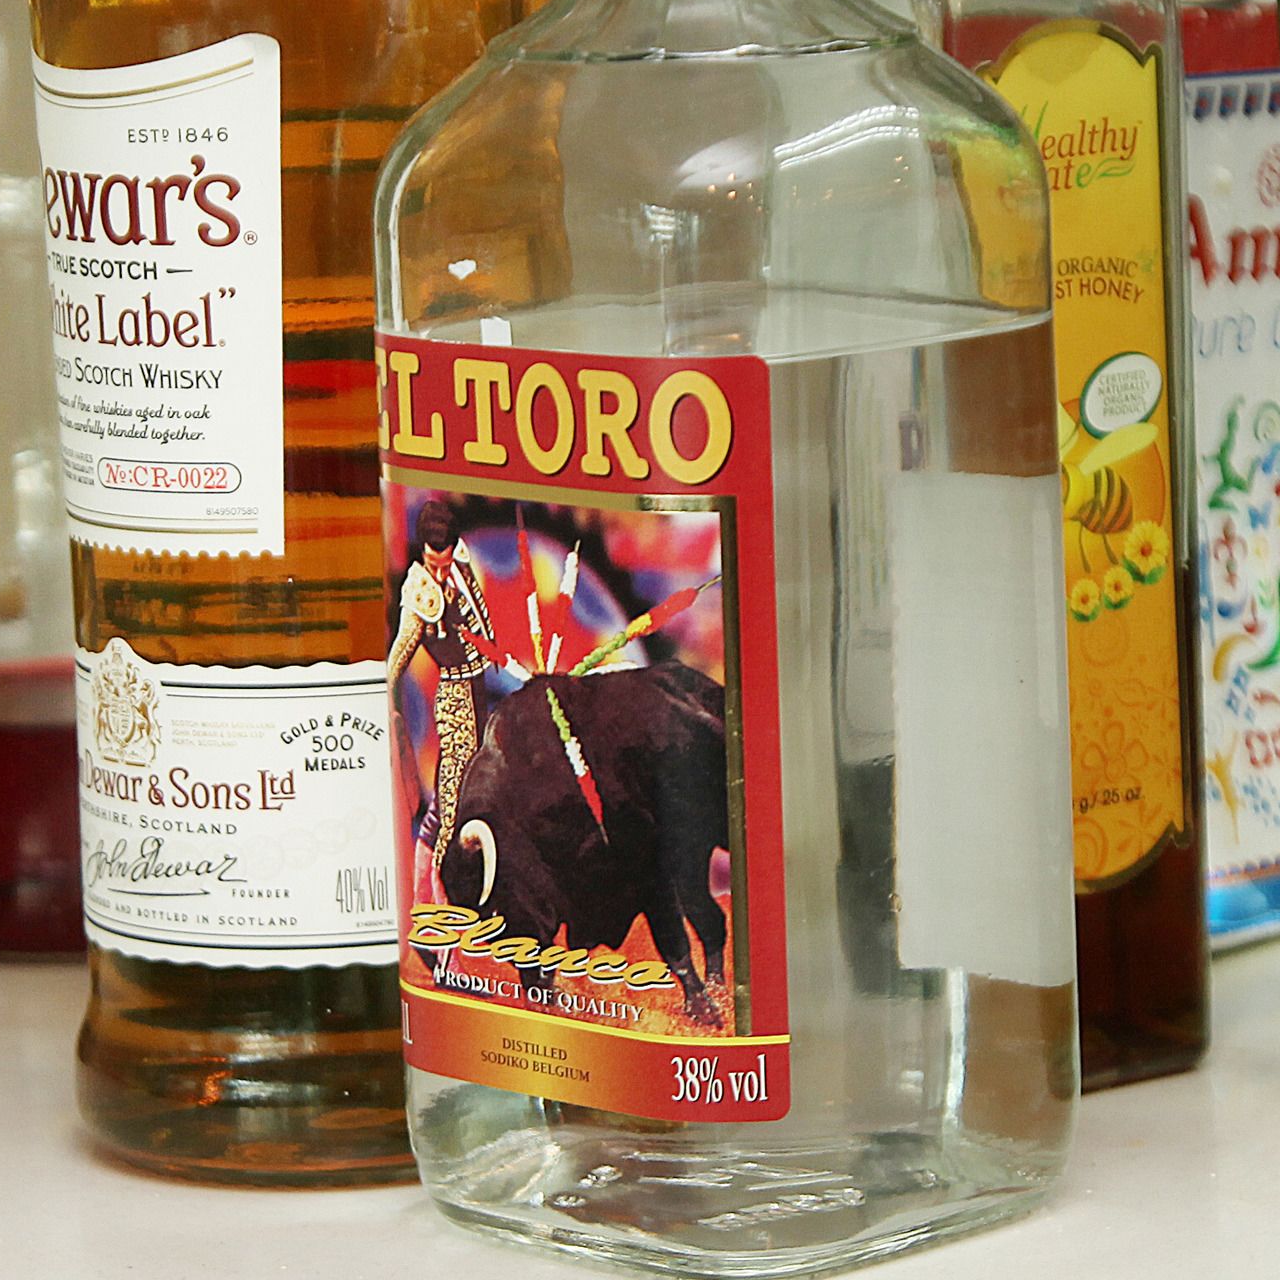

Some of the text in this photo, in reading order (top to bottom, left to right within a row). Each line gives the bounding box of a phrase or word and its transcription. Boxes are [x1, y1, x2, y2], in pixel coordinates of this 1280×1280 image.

[177, 126, 230, 143] 1846
[79, 257, 158, 280] SCOTCH
[1056, 255, 1139, 279] ORGANIC
[1079, 276, 1145, 305] HONEY
[92, 399, 134, 418] whiskies
[134, 403, 165, 423] aged
[166, 406, 183, 420] in
[183, 403, 212, 420] oak
[453, 360, 733, 485] TORO
[106, 421, 149, 440] blended
[150, 424, 206, 445] together.
[279, 711, 385, 746] GOLD & PRIZE
[311, 733, 355, 754] 500
[304, 755, 367, 772] MEDALS
[84, 747, 143, 803] Dewar
[147, 773, 166, 808] &
[168, 766, 252, 812] Sons
[256, 768, 297, 812] Ltd
[138, 813, 239, 836] SCOTLAND
[231, 887, 291, 899] FOUNDER
[335, 866, 390, 914] 40% Vol
[136, 906, 189, 924] BOTTLED
[195, 914, 212, 925] IN
[217, 916, 299, 927] SCOTLAND
[407, 902, 677, 992] Blanco
[433, 963, 645, 1022] PRODUCT OF QUALITY
[501, 1036, 569, 1062] DISTILLED
[479, 1048, 591, 1084] SODIKO BELGIUM
[670, 1053, 770, 1104] 38% vol
